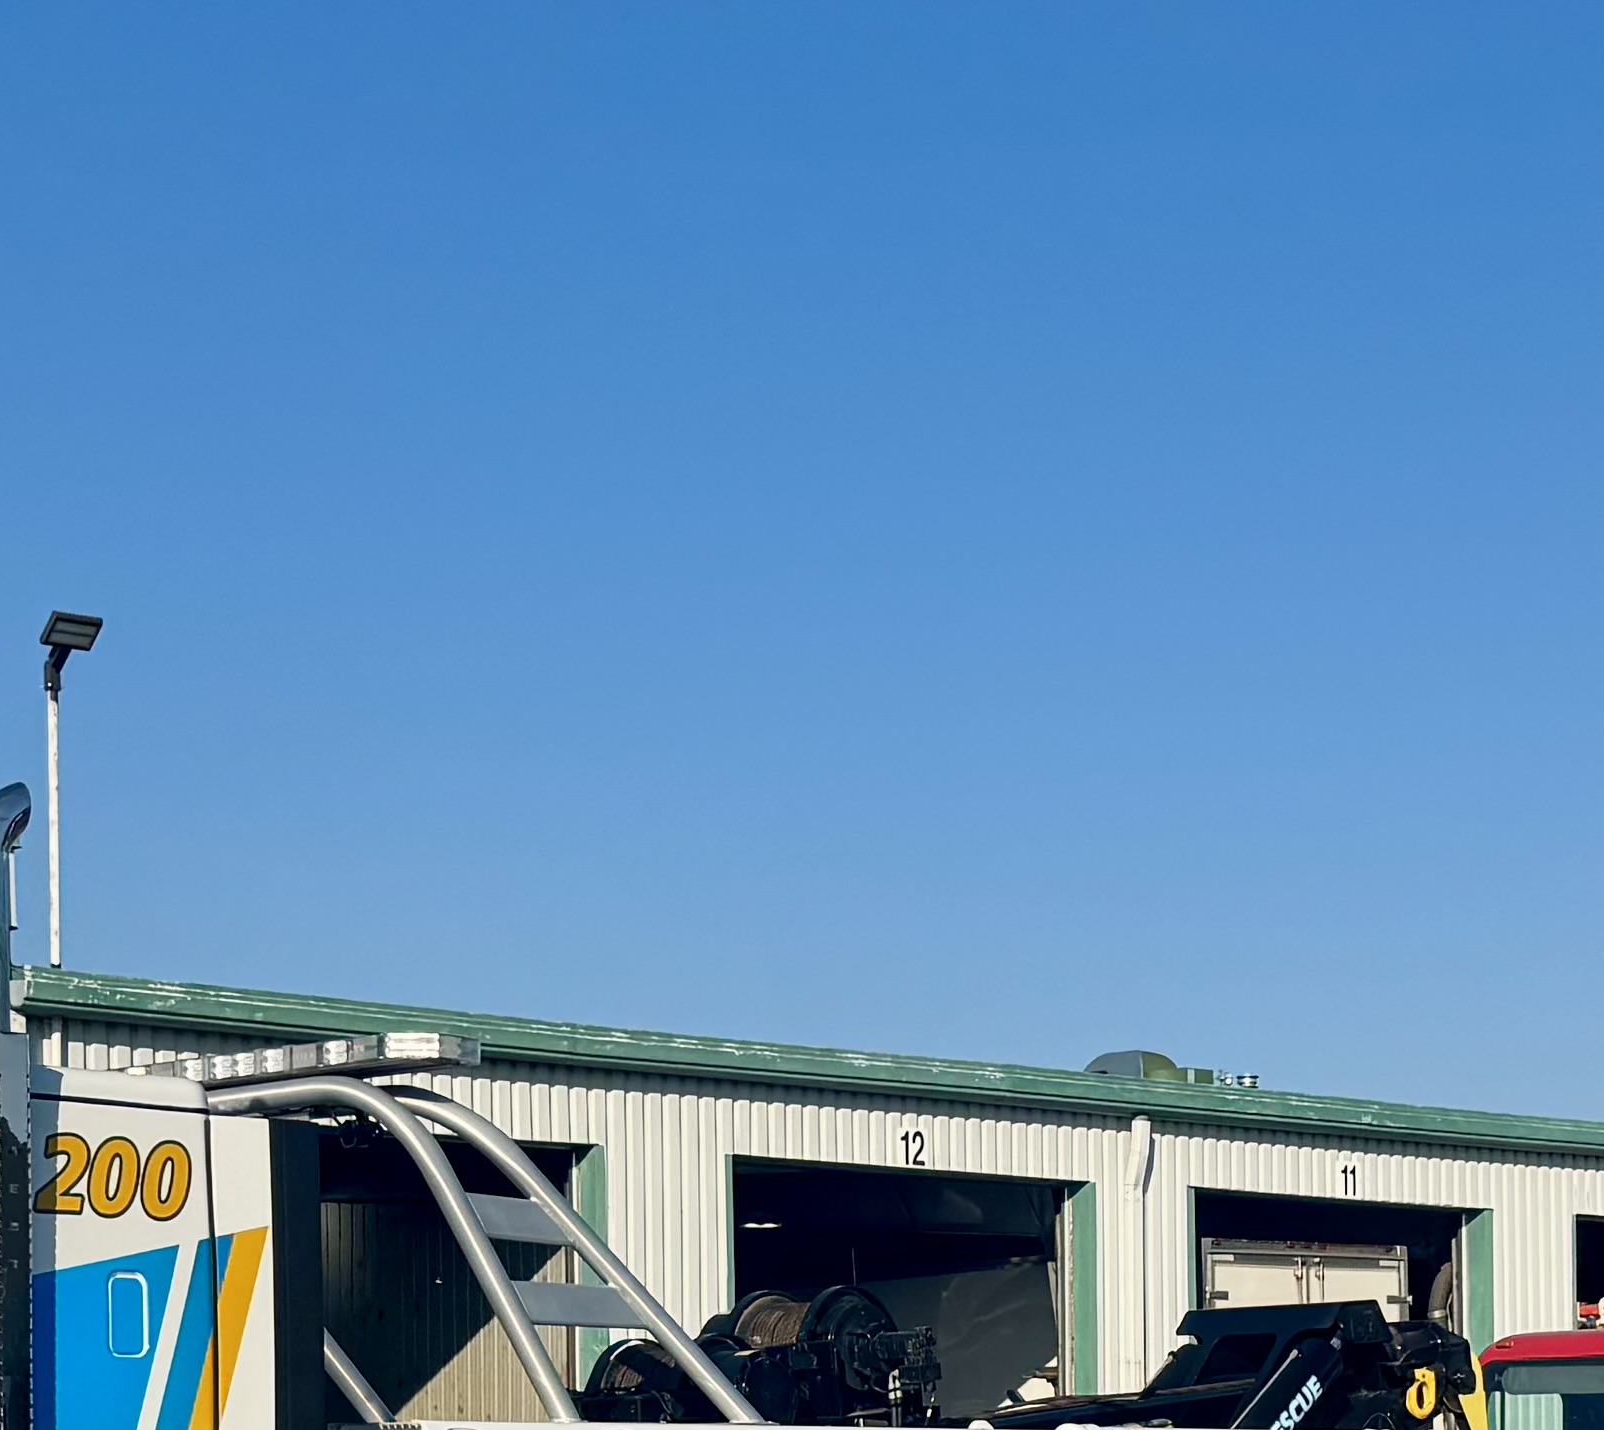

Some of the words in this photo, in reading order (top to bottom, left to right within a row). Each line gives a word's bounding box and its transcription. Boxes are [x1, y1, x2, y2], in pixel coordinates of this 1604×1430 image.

[900, 1130, 926, 1167] 12
[32, 1132, 193, 1221] 200
[1341, 1164, 1357, 1197] 11
